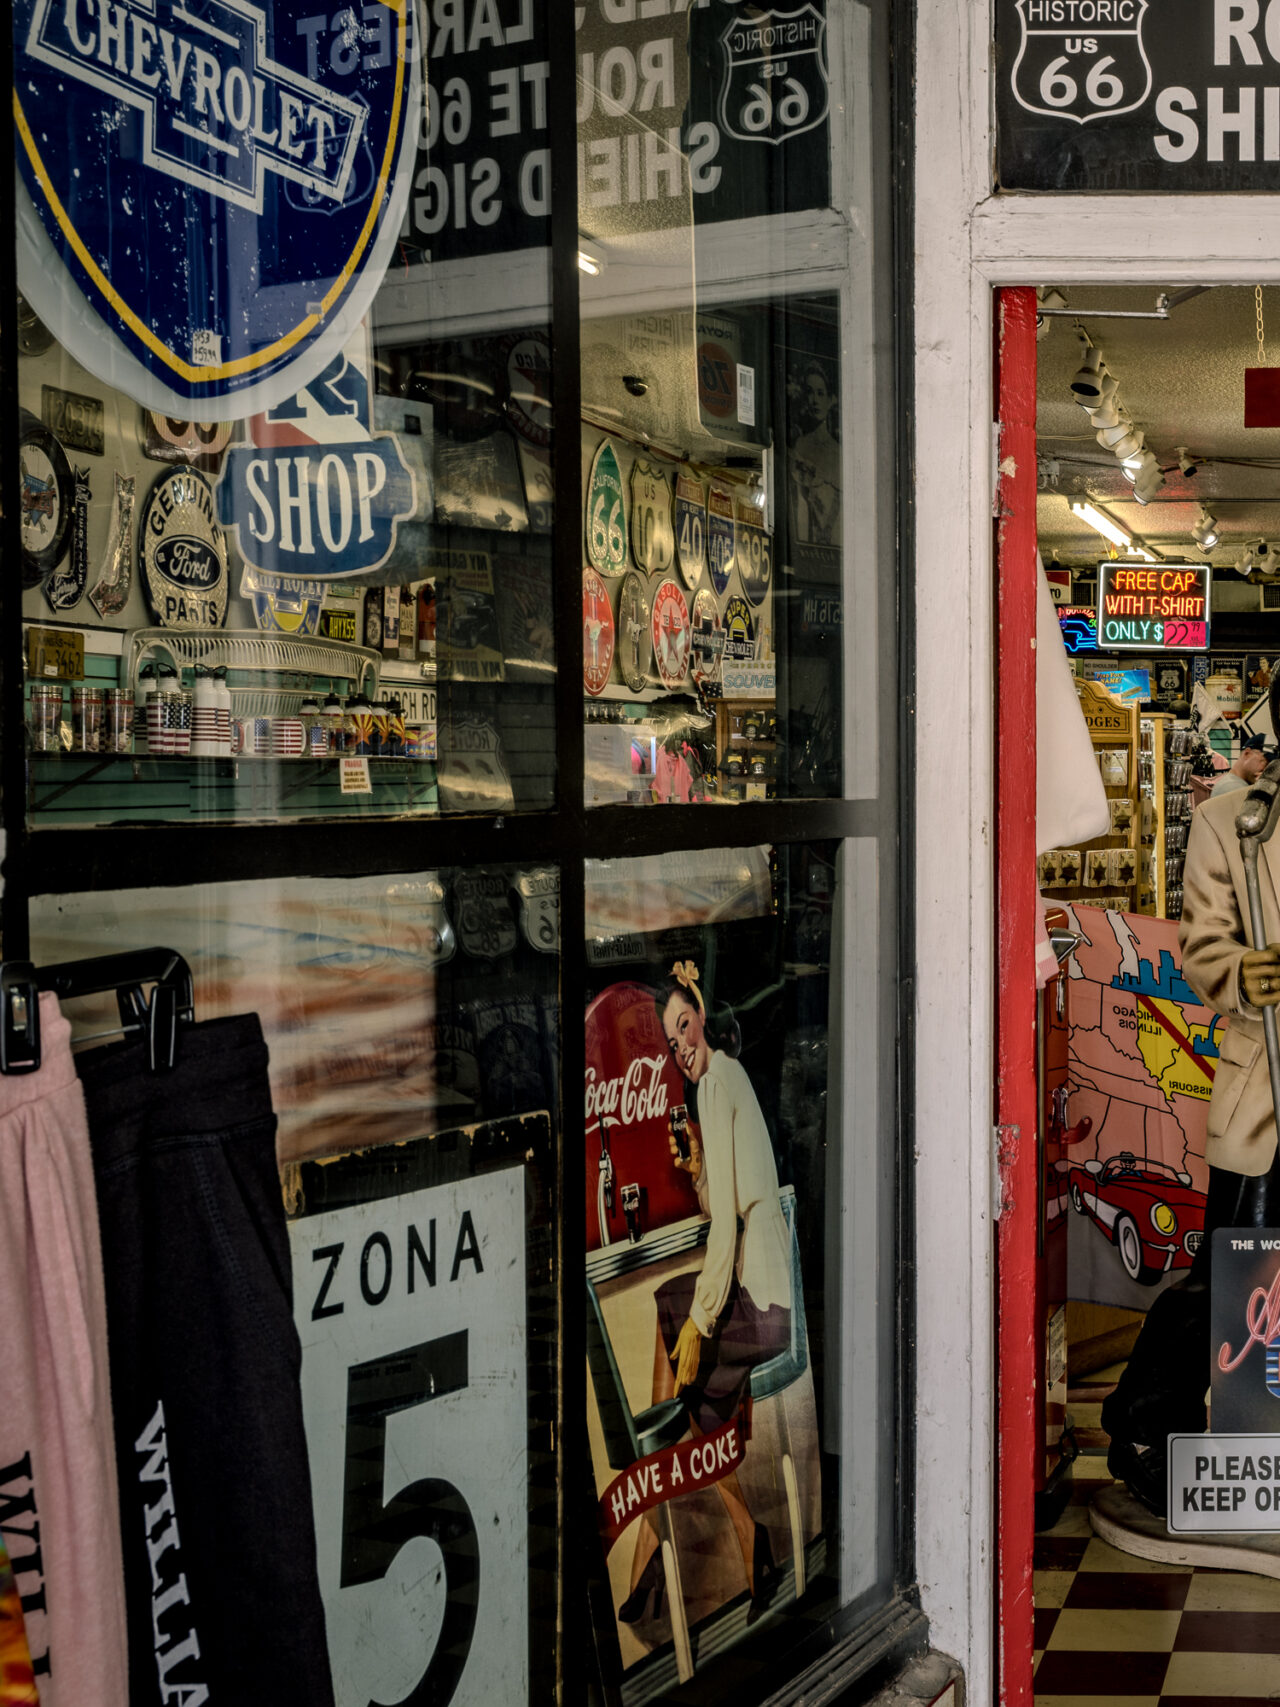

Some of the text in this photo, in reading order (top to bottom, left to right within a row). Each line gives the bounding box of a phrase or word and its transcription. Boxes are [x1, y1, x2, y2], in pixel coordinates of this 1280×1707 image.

[1028, 0, 1135, 23] HISTORIC
[1064, 38, 1099, 54] US
[64, 0, 337, 172] CHEVROLET
[1037, 56, 1125, 108] 66
[150, 476, 223, 546] GENUINE
[245, 452, 389, 555] SHOP
[644, 482, 656, 500] US
[592, 492, 625, 563] 66
[637, 504, 665, 564] 101
[680, 513, 702, 561] 40
[169, 542, 212, 582] Ford
[1115, 571, 1196, 592] FREE CAP
[165, 596, 218, 626] PARTS
[727, 600, 750, 626] SUPER
[1105, 595, 1204, 616] WITH T-SHIRT
[1106, 620, 1150, 641] ONLY
[1231, 1239, 1255, 1251] THE
[311, 1210, 485, 1322] ZONA
[611, 1428, 740, 1525] HAVE A COKE
[340, 1329, 481, 1707] 5
[1182, 1486, 1247, 1512] KEEP
